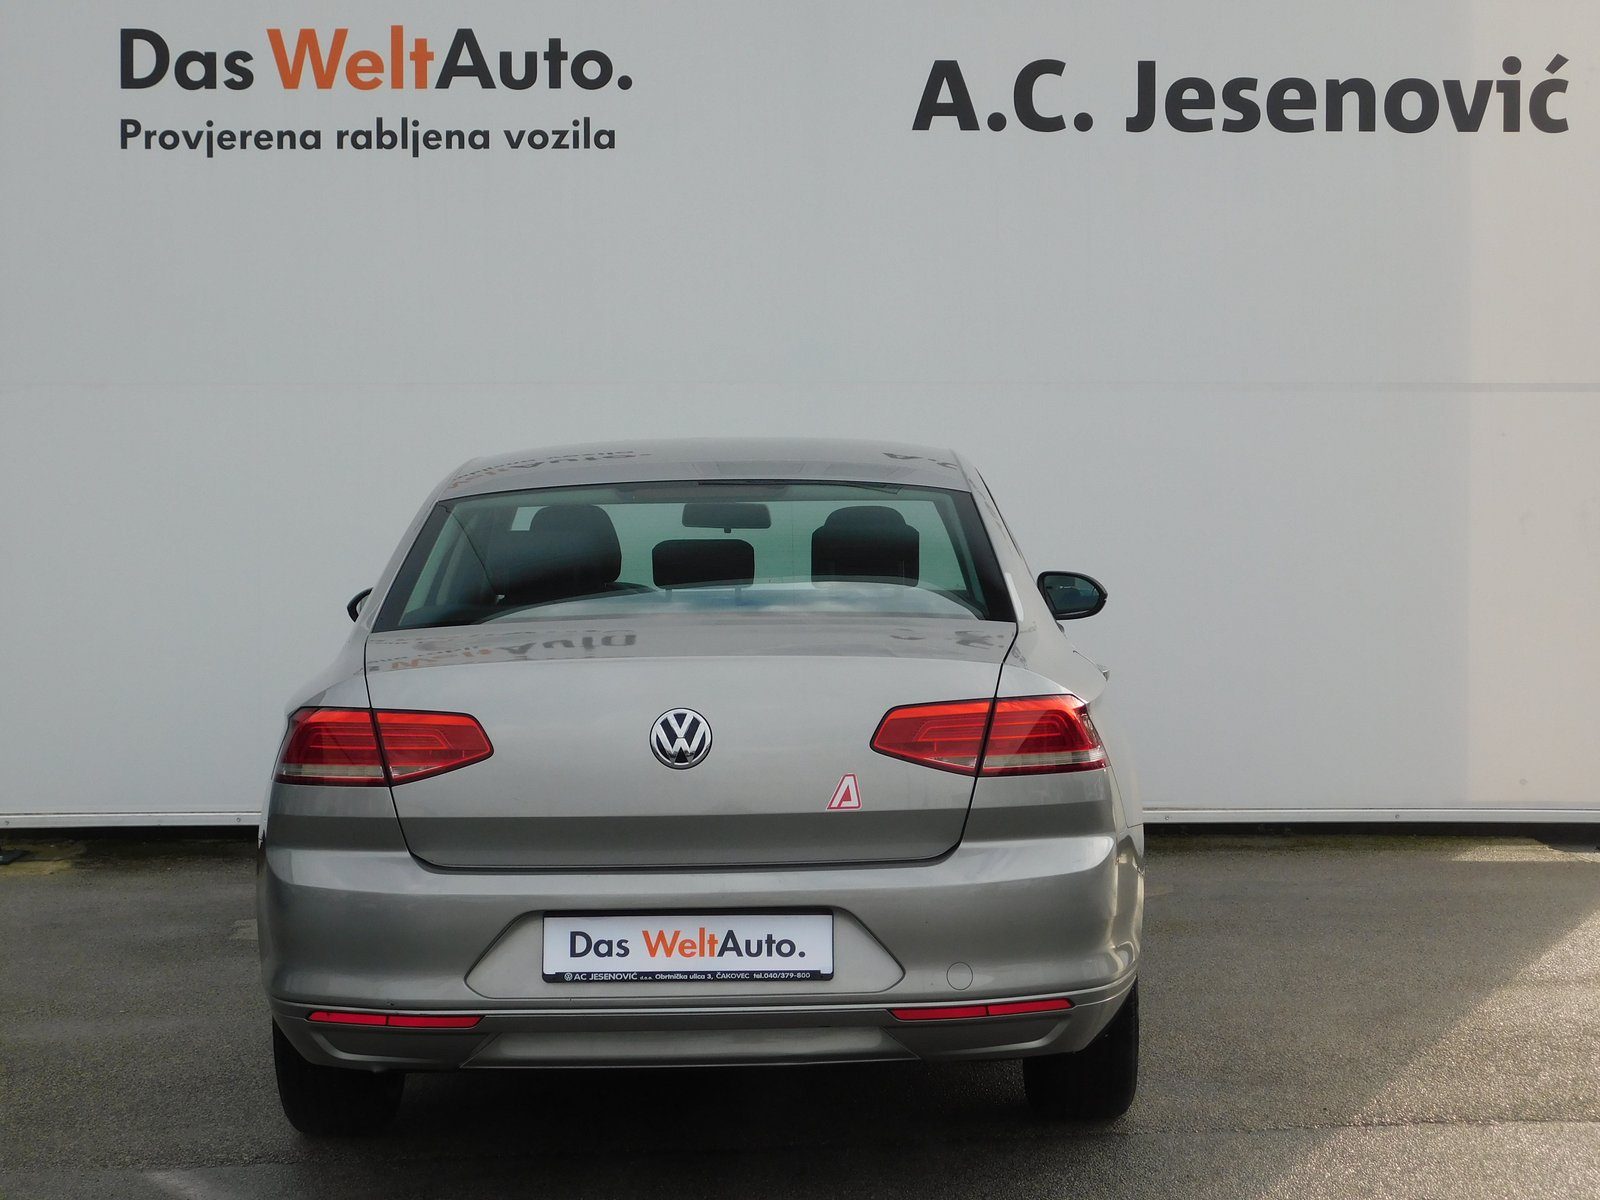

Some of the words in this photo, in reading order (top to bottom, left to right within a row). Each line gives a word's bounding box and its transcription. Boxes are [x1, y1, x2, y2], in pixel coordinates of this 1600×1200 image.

[119, 27, 254, 91] Das
[266, 24, 634, 92] WeltAuto.
[911, 58, 1095, 133] A.C.
[1125, 53, 1570, 134] Jesenović
[119, 118, 322, 159] Provjerena
[335, 116, 491, 159] rabljena
[502, 116, 617, 151] vozila
[568, 930, 630, 959] Das
[641, 926, 807, 959] WeltAuto.
[573, 972, 587, 981] AC
[588, 971, 638, 981] JESENOVIĆ
[654, 972, 688, 981] Obrtnička
[689, 972, 706, 980] ulica
[715, 971, 750, 980] ČAKOVEC
